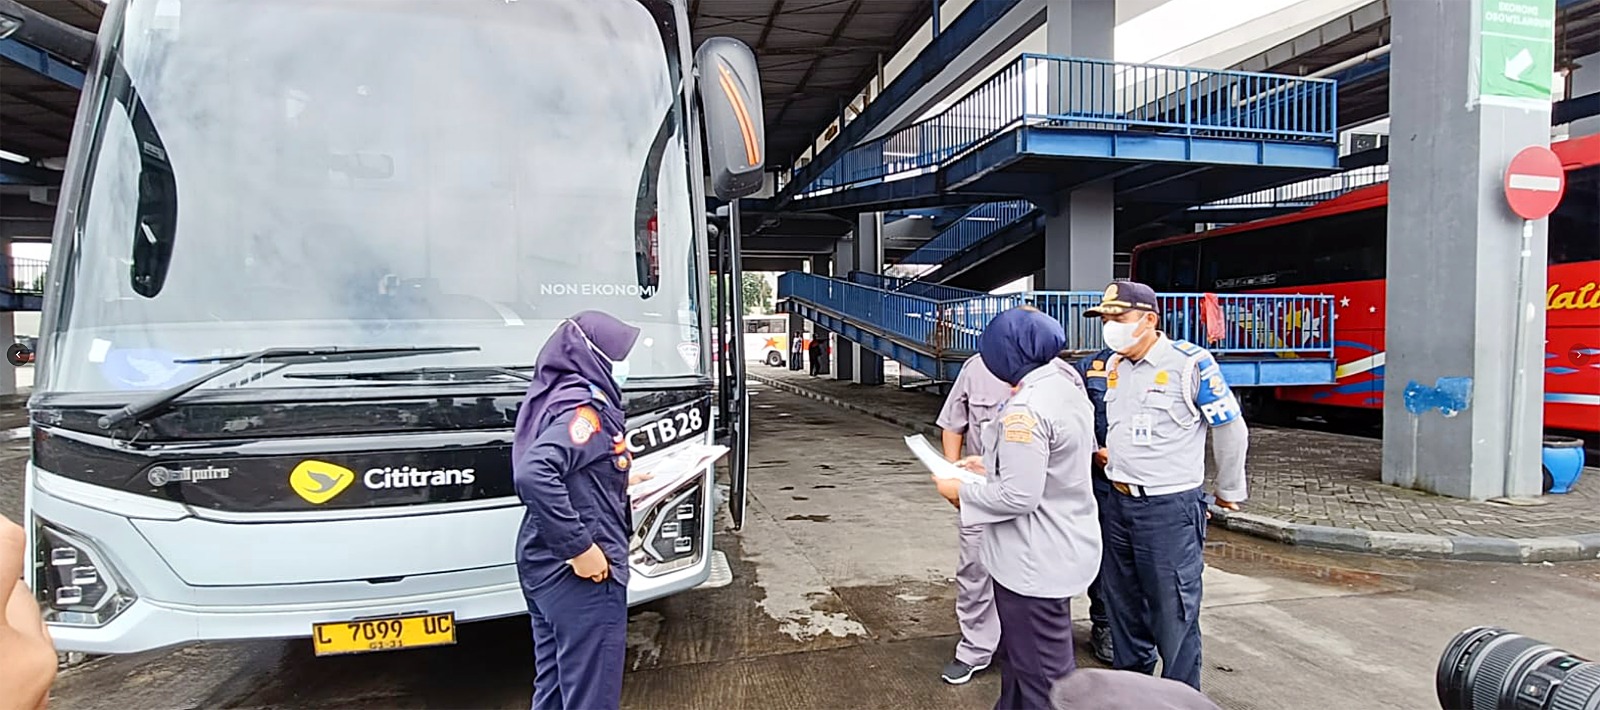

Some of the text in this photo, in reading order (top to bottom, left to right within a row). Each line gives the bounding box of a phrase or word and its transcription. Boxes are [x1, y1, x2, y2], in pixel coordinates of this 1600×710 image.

[540, 284, 656, 296] NON EKONOMI
[624, 407, 703, 453] CTB28
[363, 466, 475, 489] Cititrans
[317, 615, 451, 645] L 7099 UC
